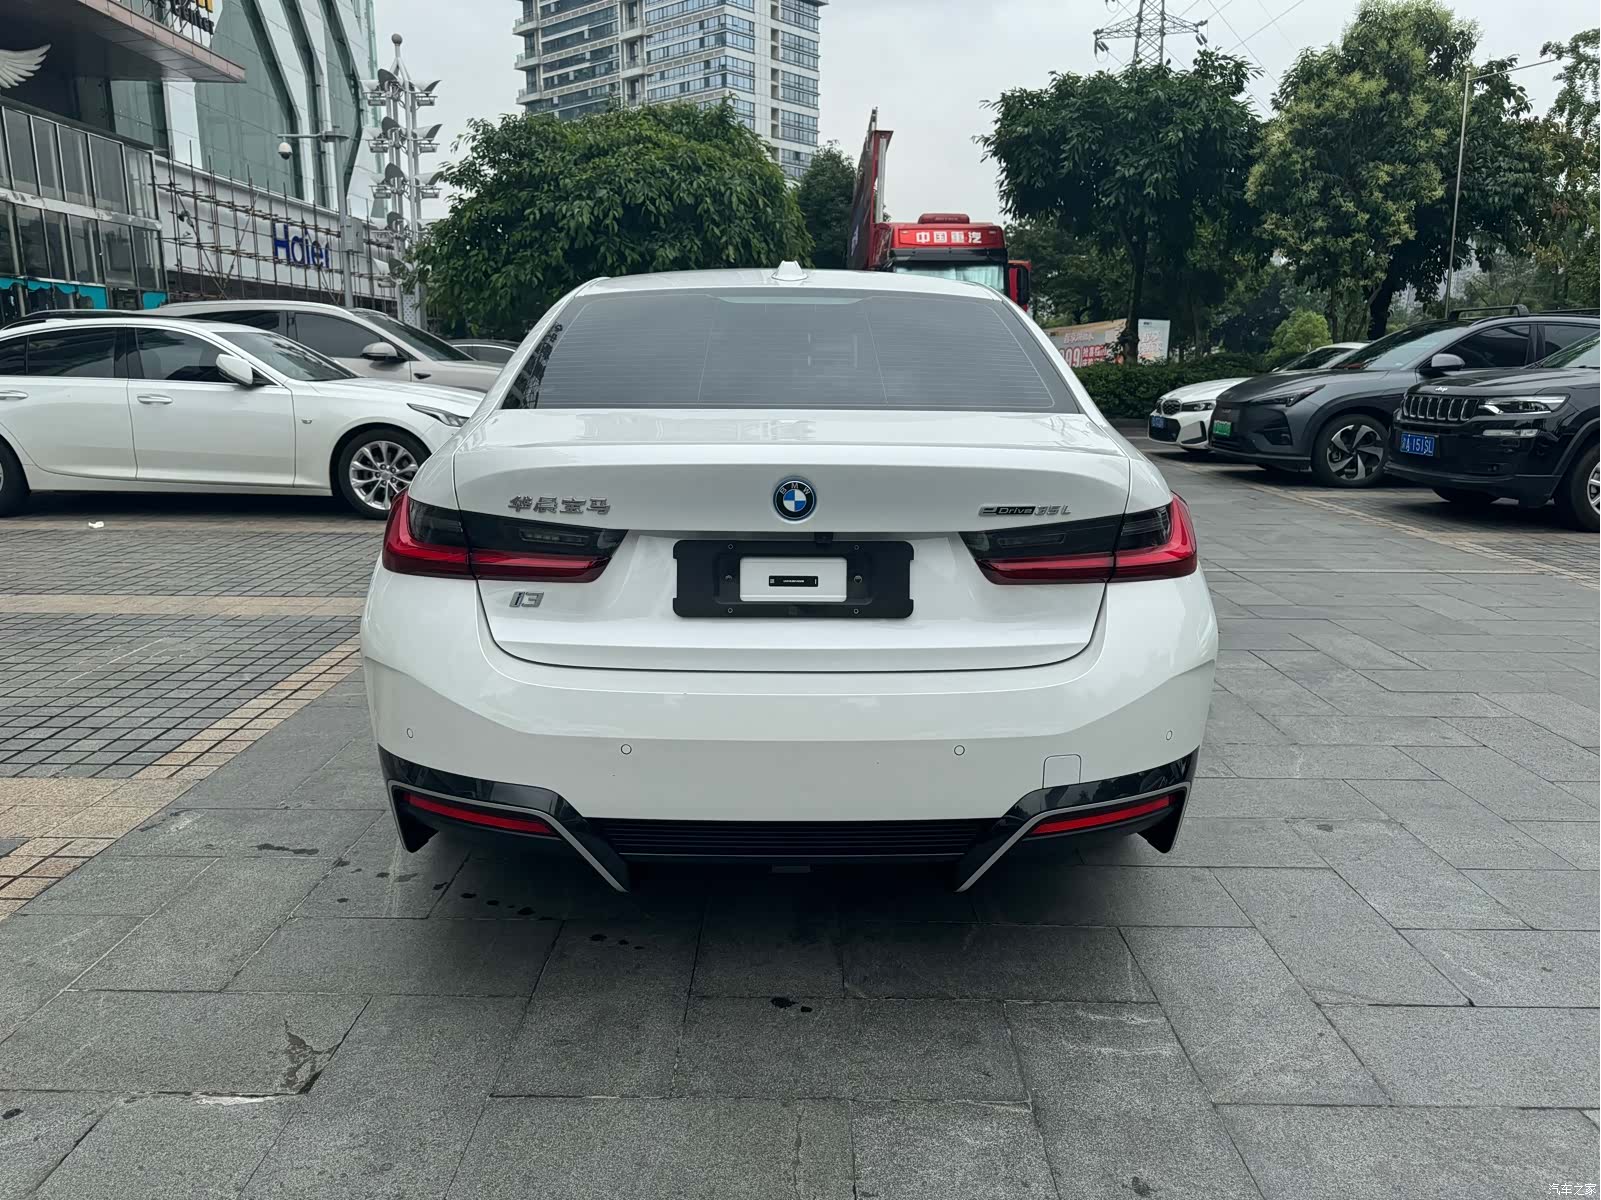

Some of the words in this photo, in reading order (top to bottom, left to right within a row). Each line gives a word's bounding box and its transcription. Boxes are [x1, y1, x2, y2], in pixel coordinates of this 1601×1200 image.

[272, 222, 330, 268] Haier
[915, 231, 982, 243] 中国重汽
[780, 482, 810, 494] BMW
[508, 496, 610, 514] 华晨宝马
[509, 591, 544, 607] i3
